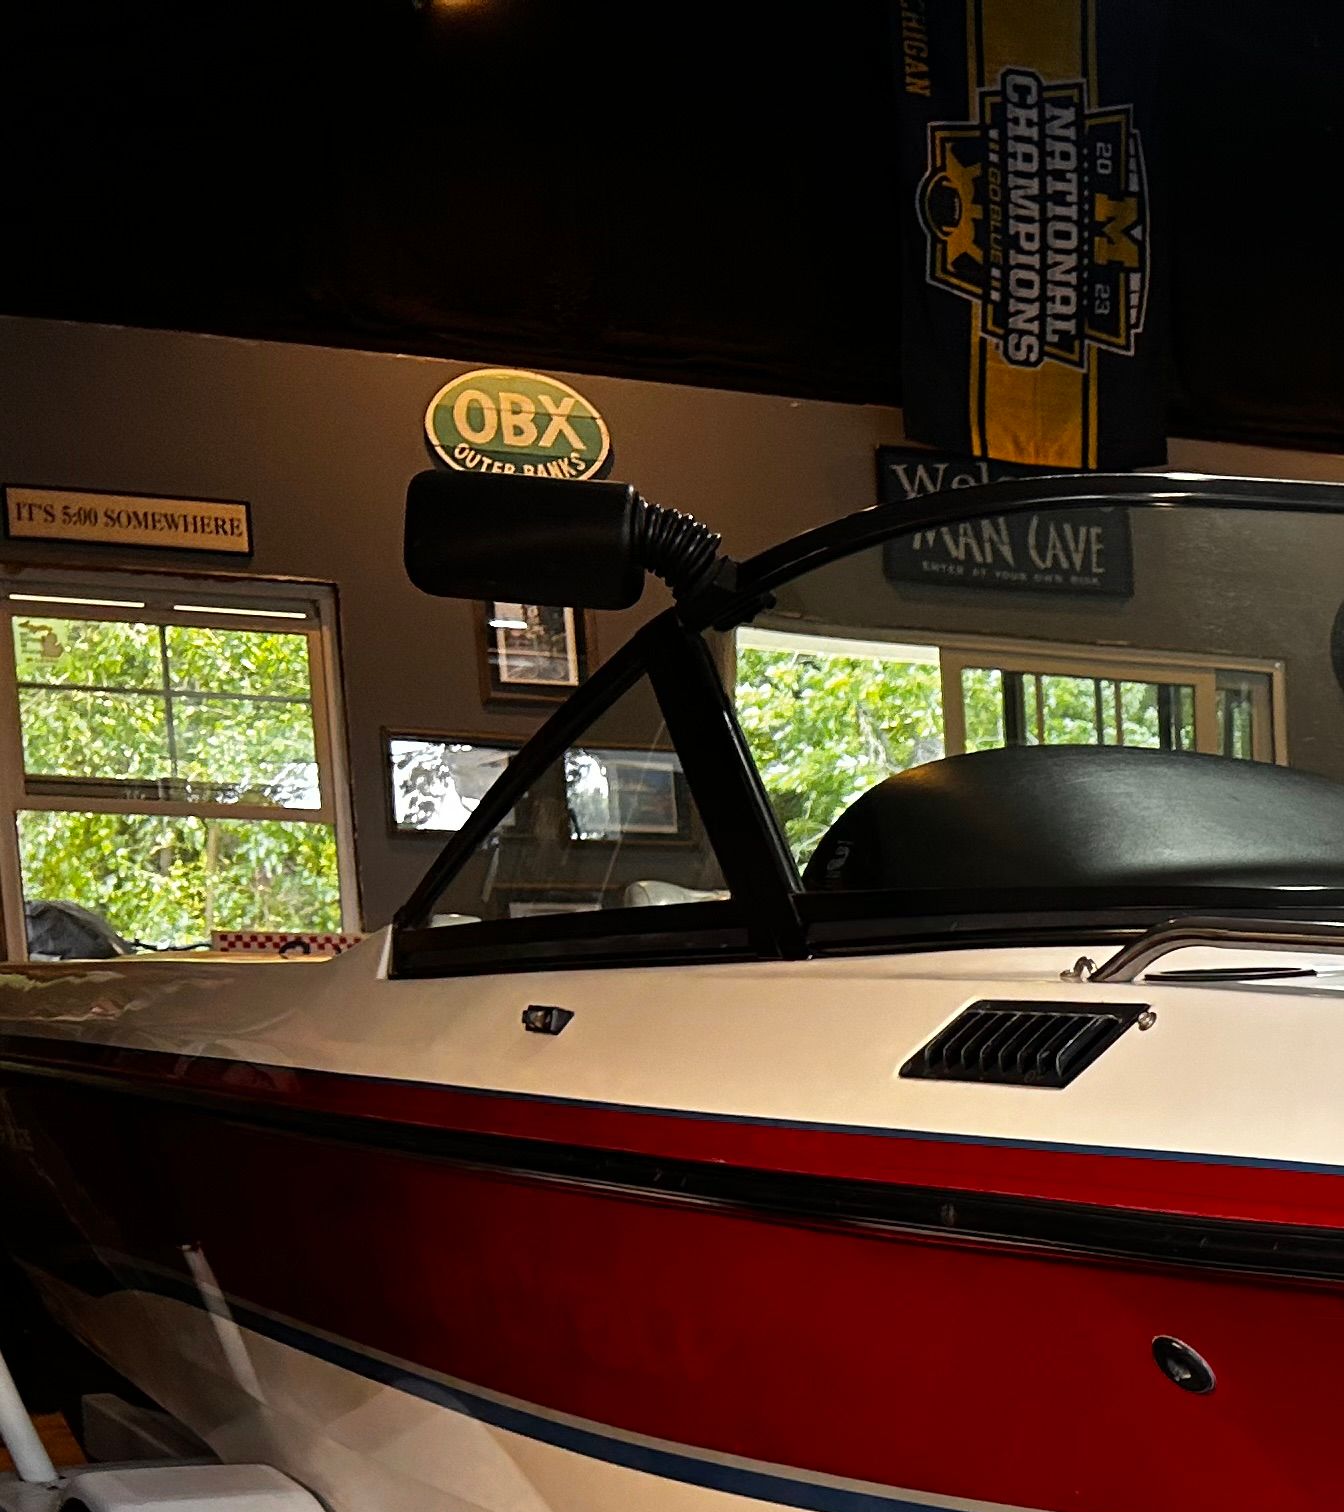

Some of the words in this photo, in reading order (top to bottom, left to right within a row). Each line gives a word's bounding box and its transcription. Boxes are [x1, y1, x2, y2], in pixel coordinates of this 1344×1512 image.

[1095, 142, 1112, 175] 20
[1005, 73, 1041, 364] CHAMPIONS
[1044, 103, 1079, 343] NATIONAL
[1094, 194, 1140, 268] M
[453, 389, 588, 450] OBX
[454, 443, 516, 475] OUTER
[523, 452, 586, 478] BANKS
[16, 502, 55, 523] IT'S
[62, 505, 98, 526] 5:00
[104, 509, 243, 538] SOMEWHERE
[1027, 514, 1105, 574] CAVE
